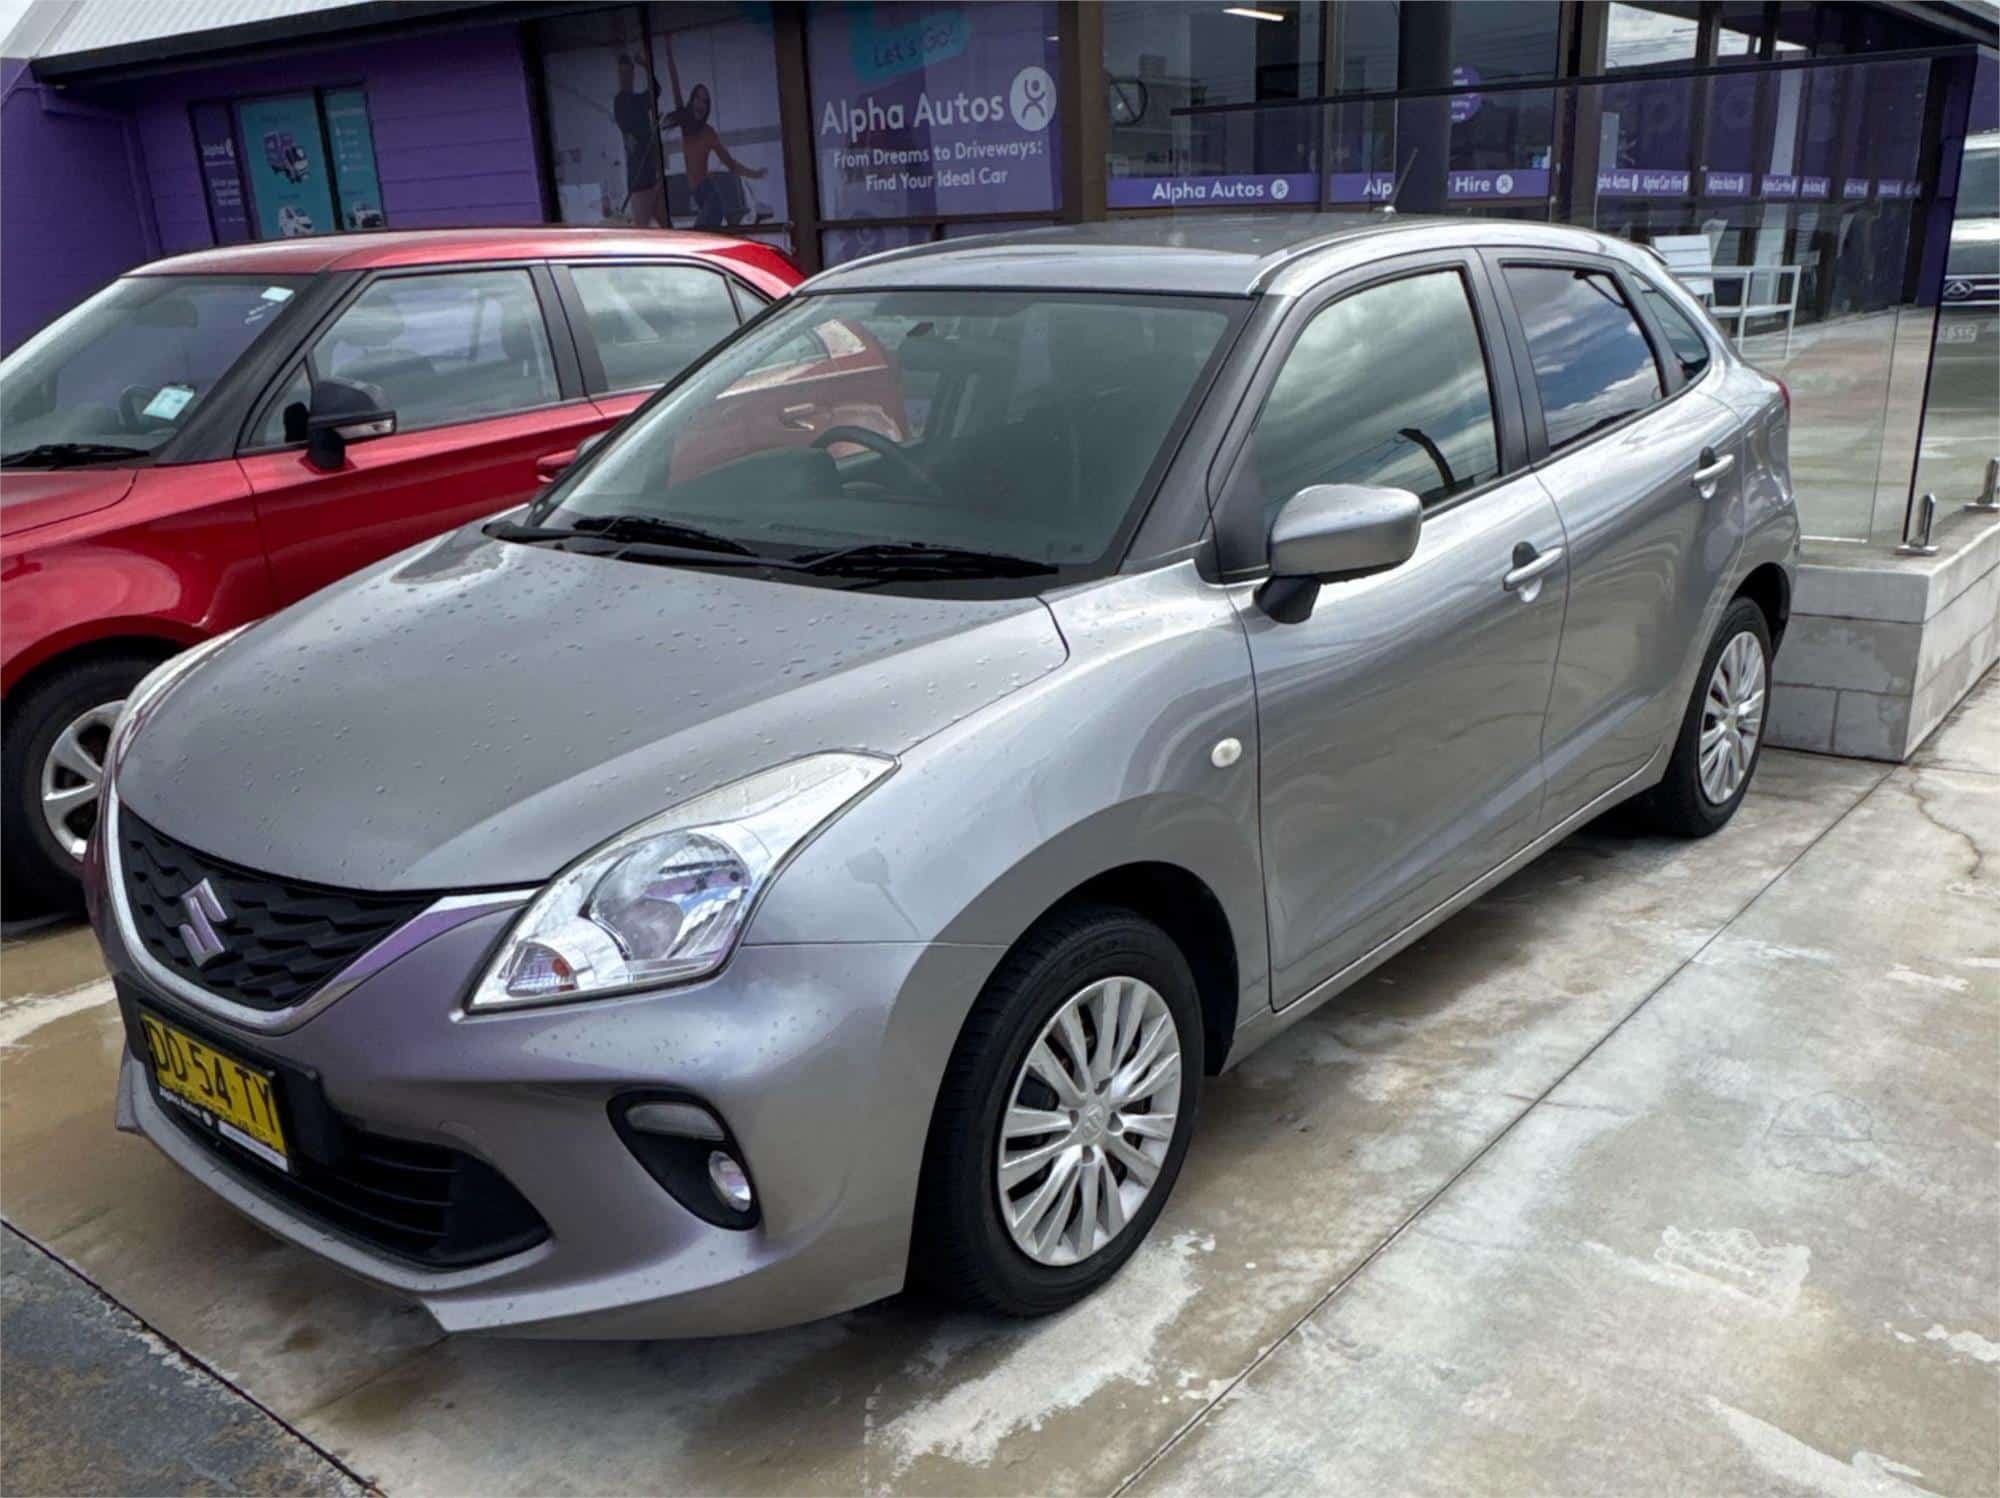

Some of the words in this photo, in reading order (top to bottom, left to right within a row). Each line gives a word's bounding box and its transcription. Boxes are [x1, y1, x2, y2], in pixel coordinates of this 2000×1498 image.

[821, 97, 904, 142] Alpha
[914, 92, 1004, 127] Autos
[833, 151, 869, 168] From
[873, 148, 930, 165] Dreams
[934, 145, 951, 160] to
[955, 140, 1042, 160] Driveways:
[865, 173, 897, 191] Find
[900, 171, 933, 190] Your
[937, 168, 976, 187] Ideal
[979, 166, 1008, 185] Car
[1363, 179, 1393, 199] Alp
[1455, 175, 1491, 193] Hire
[1152, 181, 1206, 205] Alpha
[1211, 180, 1264, 198] Autos
